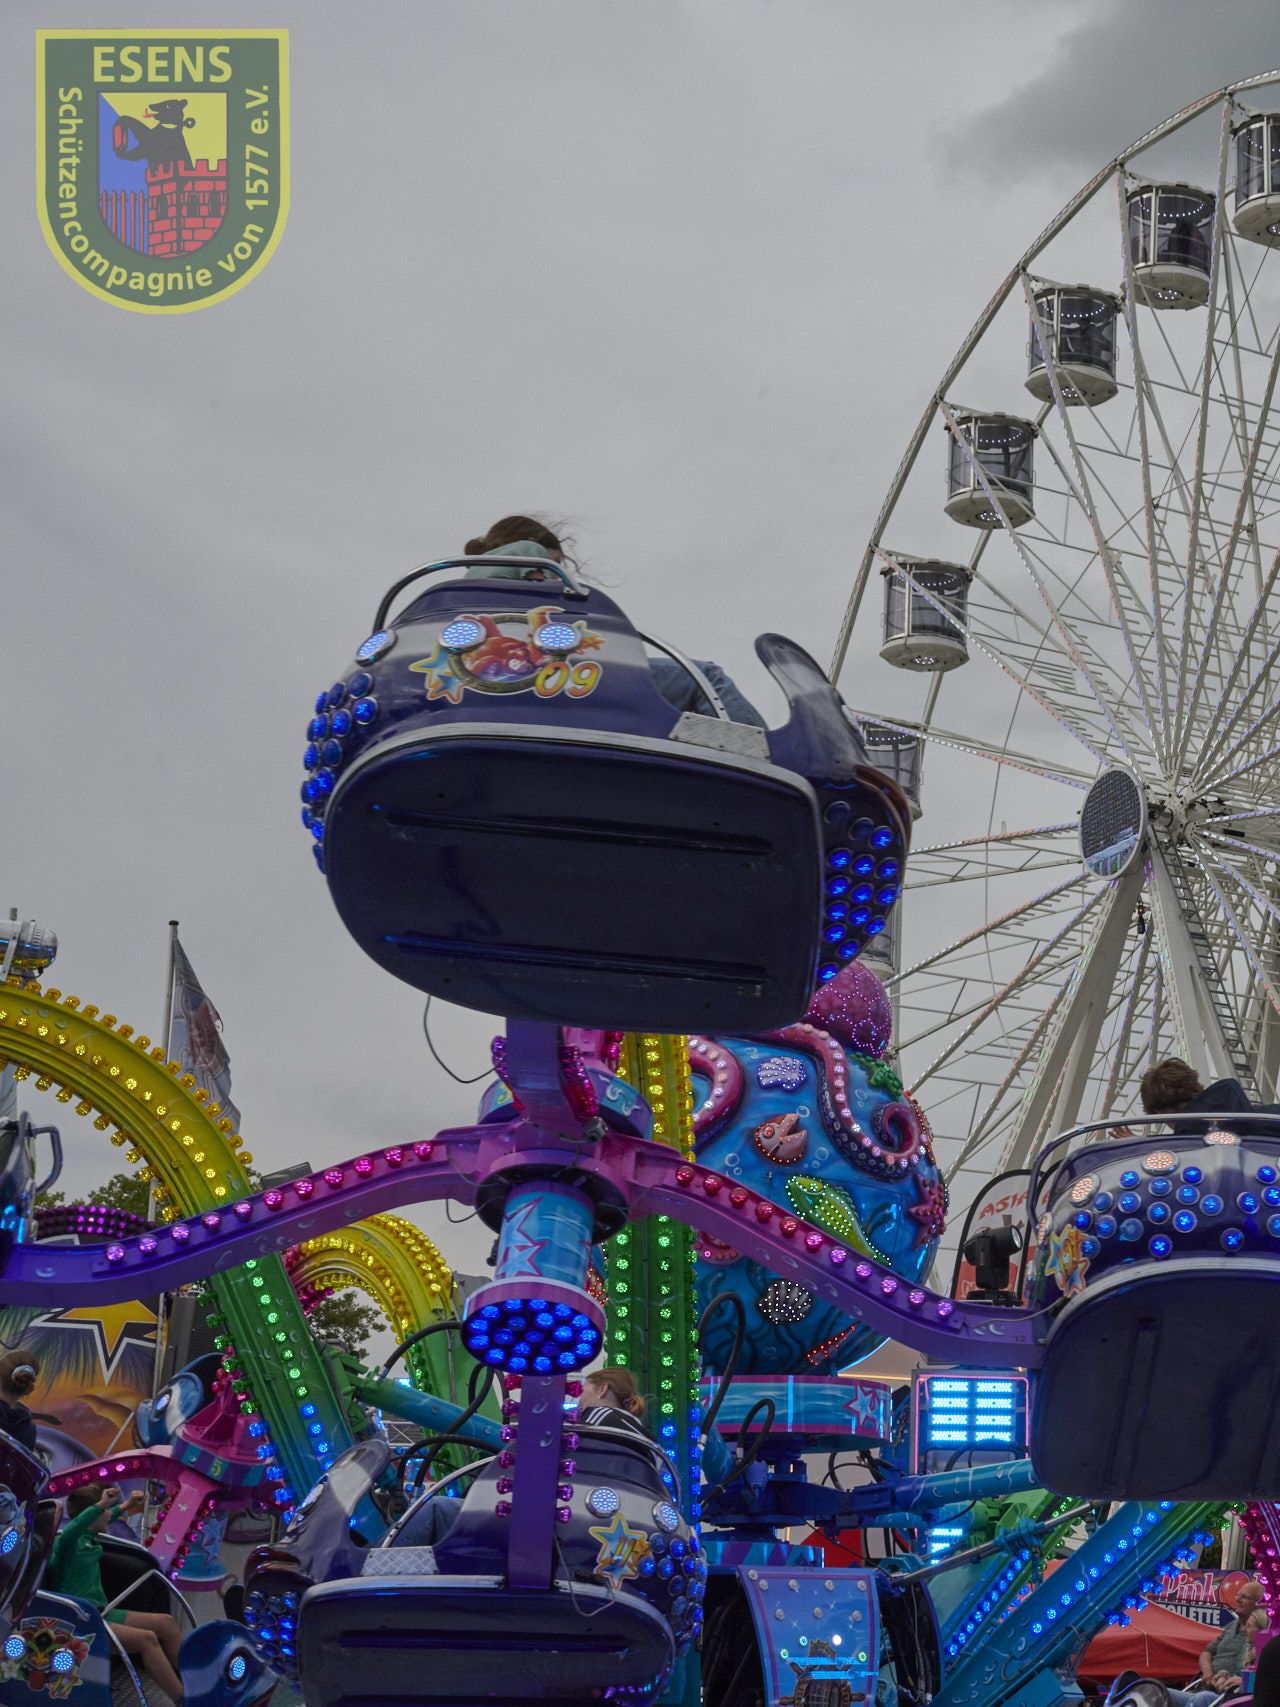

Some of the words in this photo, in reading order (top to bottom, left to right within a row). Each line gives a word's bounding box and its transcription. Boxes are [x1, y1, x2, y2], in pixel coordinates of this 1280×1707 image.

[535, 660, 603, 699] 09
[211, 1458, 223, 1477] 5
[1159, 1572, 1218, 1606] Pink
